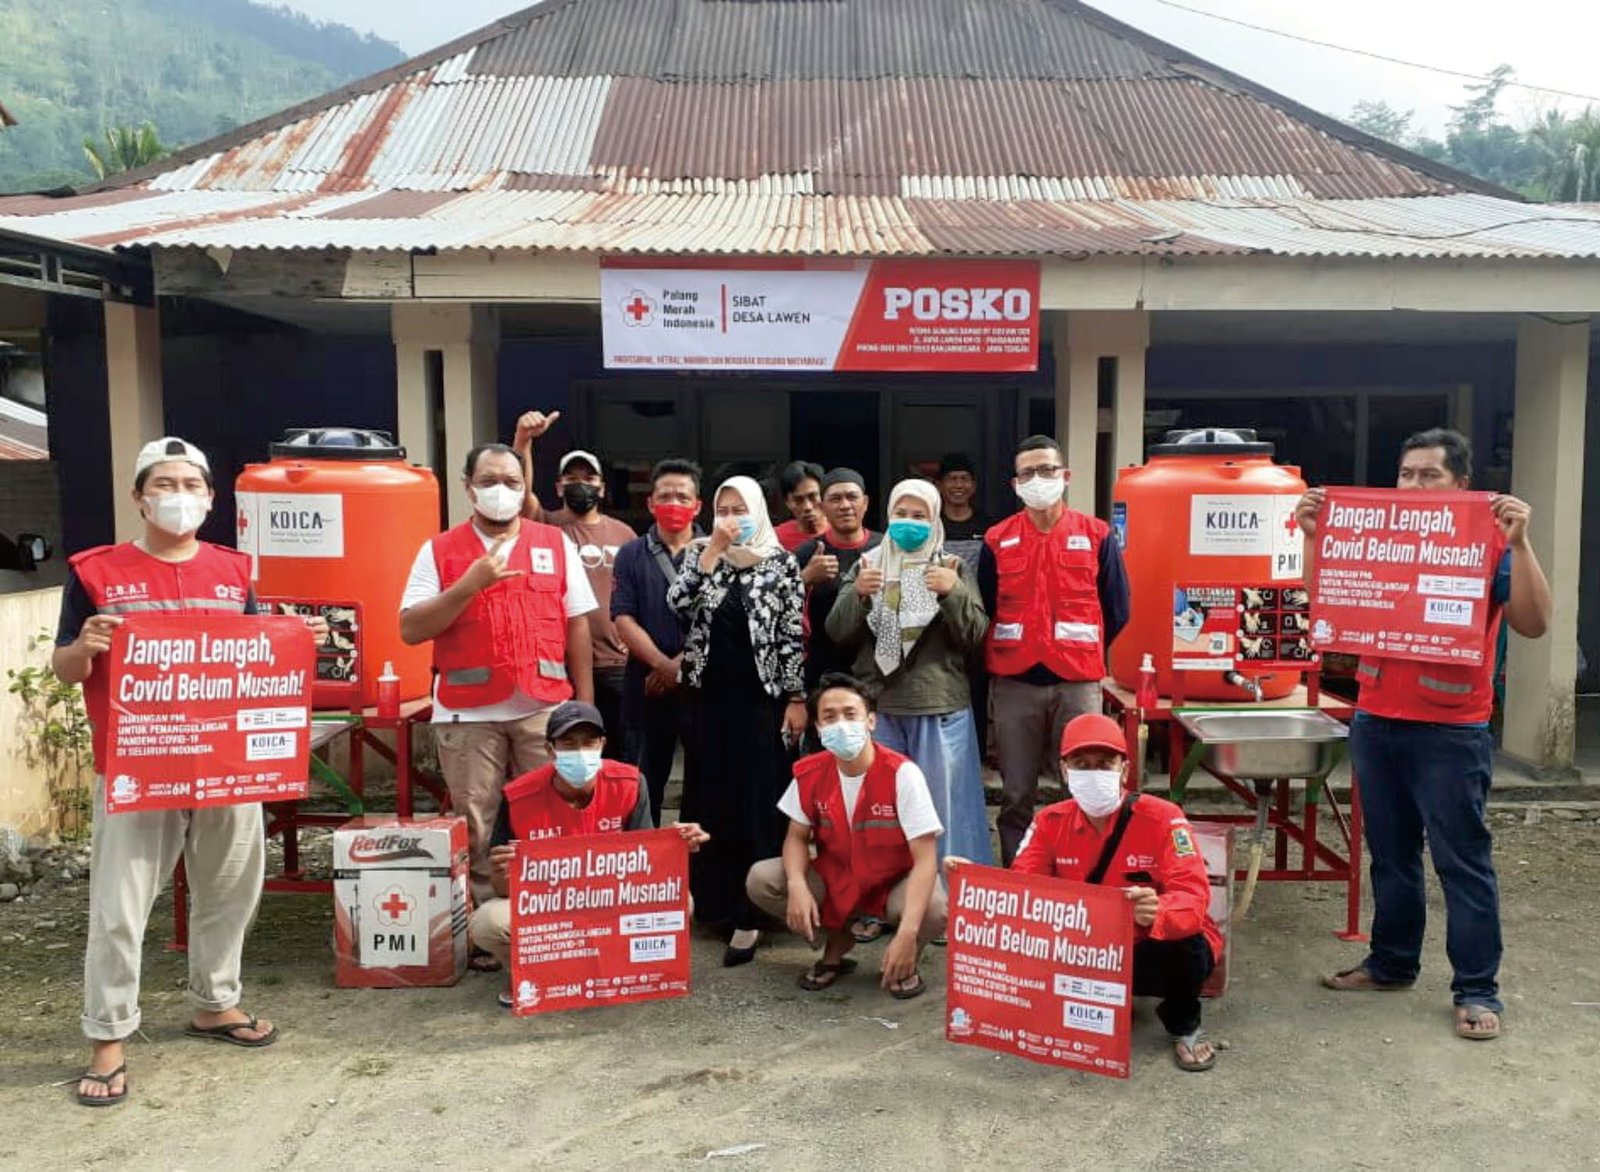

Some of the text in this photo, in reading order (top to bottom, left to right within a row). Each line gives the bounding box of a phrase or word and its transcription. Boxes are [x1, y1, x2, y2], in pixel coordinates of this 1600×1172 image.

[663, 289, 698, 301] Palang
[732, 296, 767, 308] SIBAT
[883, 287, 1031, 321] POSKO
[663, 304, 695, 315] Merah
[732, 312, 811, 324] DESA LAWEN
[663, 318, 715, 328] Indonesia
[270, 511, 323, 529] KOICA
[1206, 511, 1259, 529] KOICA
[1327, 501, 1456, 537] Jangan Lengah,
[1322, 535, 1486, 568] Covid Belum Musnah!
[124, 632, 275, 671] Jangan Lengah,
[119, 670, 304, 702] Covid Belum Musnah!
[251, 735, 286, 748] KOICA
[350, 834, 424, 852] RedFox
[520, 845, 652, 886] Jangan Lengah,
[518, 877, 681, 916] Covid Belum Musnah!
[957, 878, 1091, 936] Jangan Lengah,
[373, 934, 416, 952] PMI
[954, 916, 1124, 972] Covid Belum Musnah!
[1069, 1004, 1104, 1021] KOICA
